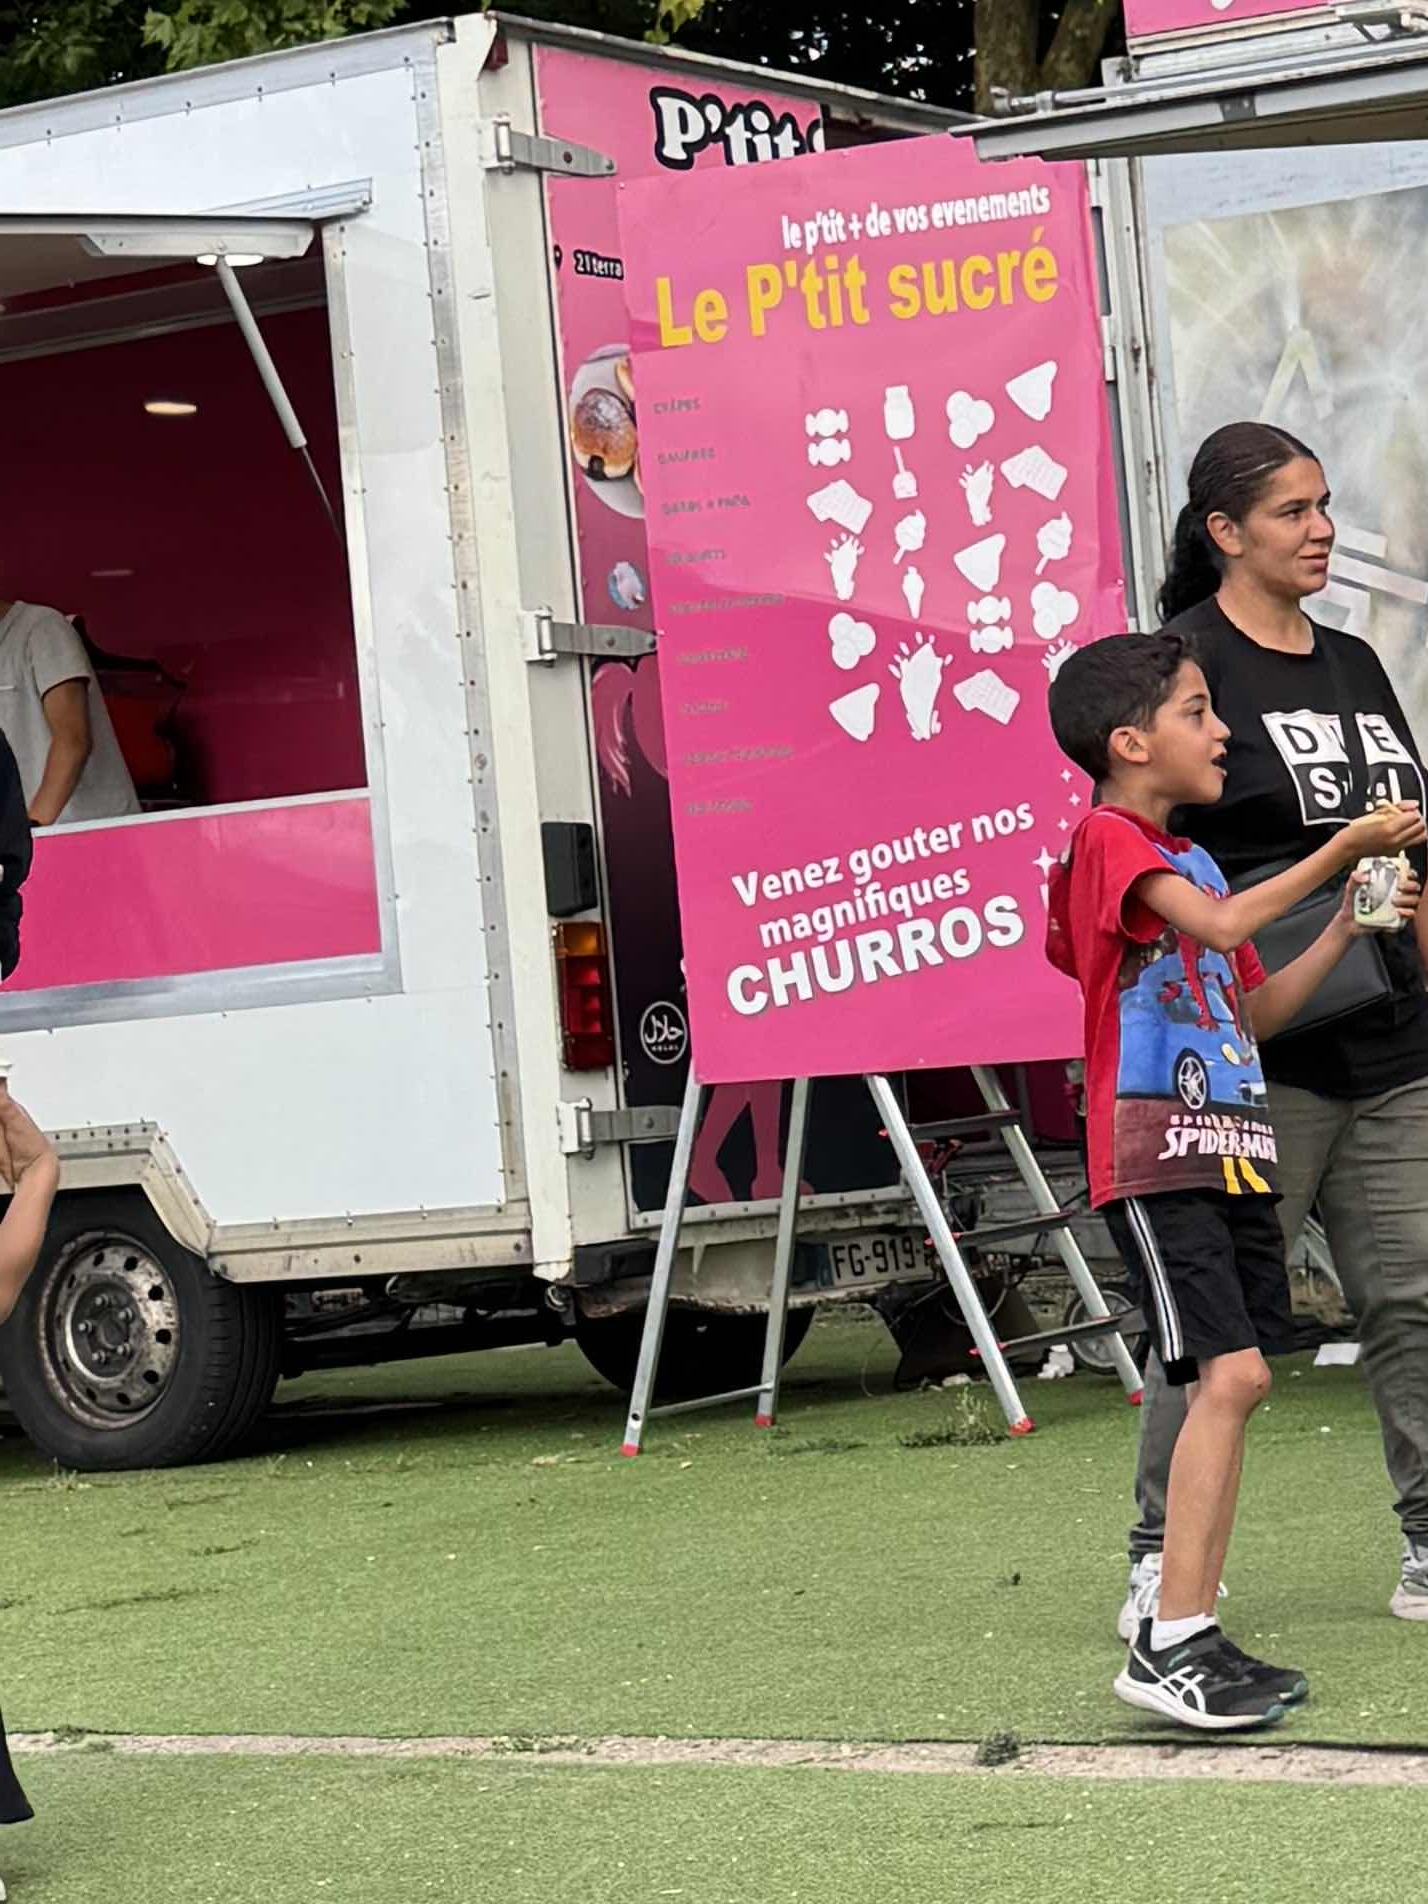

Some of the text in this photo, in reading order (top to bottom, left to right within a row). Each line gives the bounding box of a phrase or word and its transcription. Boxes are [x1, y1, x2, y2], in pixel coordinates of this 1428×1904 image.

[654, 94, 800, 166] P'tit
[781, 214, 804, 250] le
[804, 204, 845, 255] p'tit
[866, 203, 891, 238] de
[898, 202, 929, 234] vos
[931, 183, 1051, 229] evenements
[656, 228, 1058, 348] Le P'tit sucré
[732, 801, 1035, 907] Venez gouter nos
[759, 866, 971, 948] magnifiques
[727, 895, 1024, 1016] CHURROS
